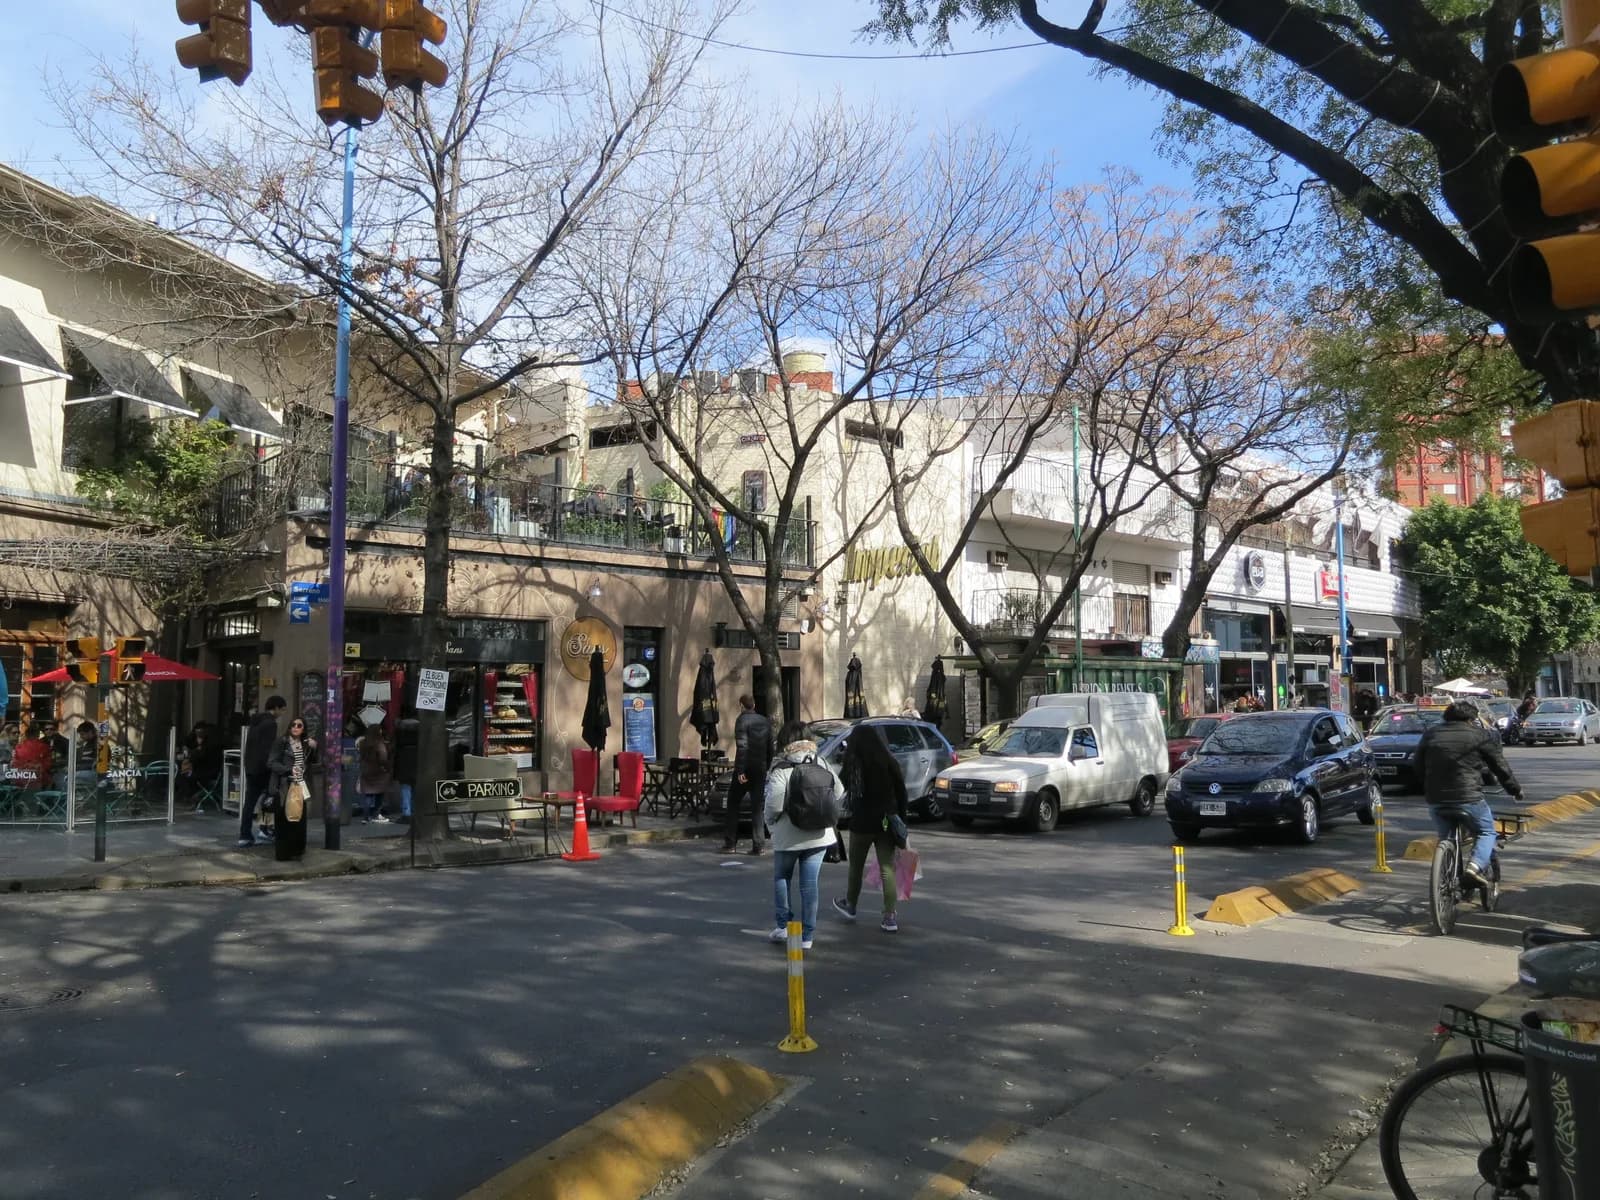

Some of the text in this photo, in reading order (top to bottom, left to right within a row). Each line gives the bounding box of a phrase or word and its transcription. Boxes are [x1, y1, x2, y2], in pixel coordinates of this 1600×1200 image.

[293, 585, 320, 594] Serrano
[445, 641, 464, 654] Sans
[431, 672, 444, 681] BUEN
[4, 771, 37, 779] GANCIA
[467, 782, 515, 797] PARKING
[1567, 1050, 1597, 1062] Ciudad
